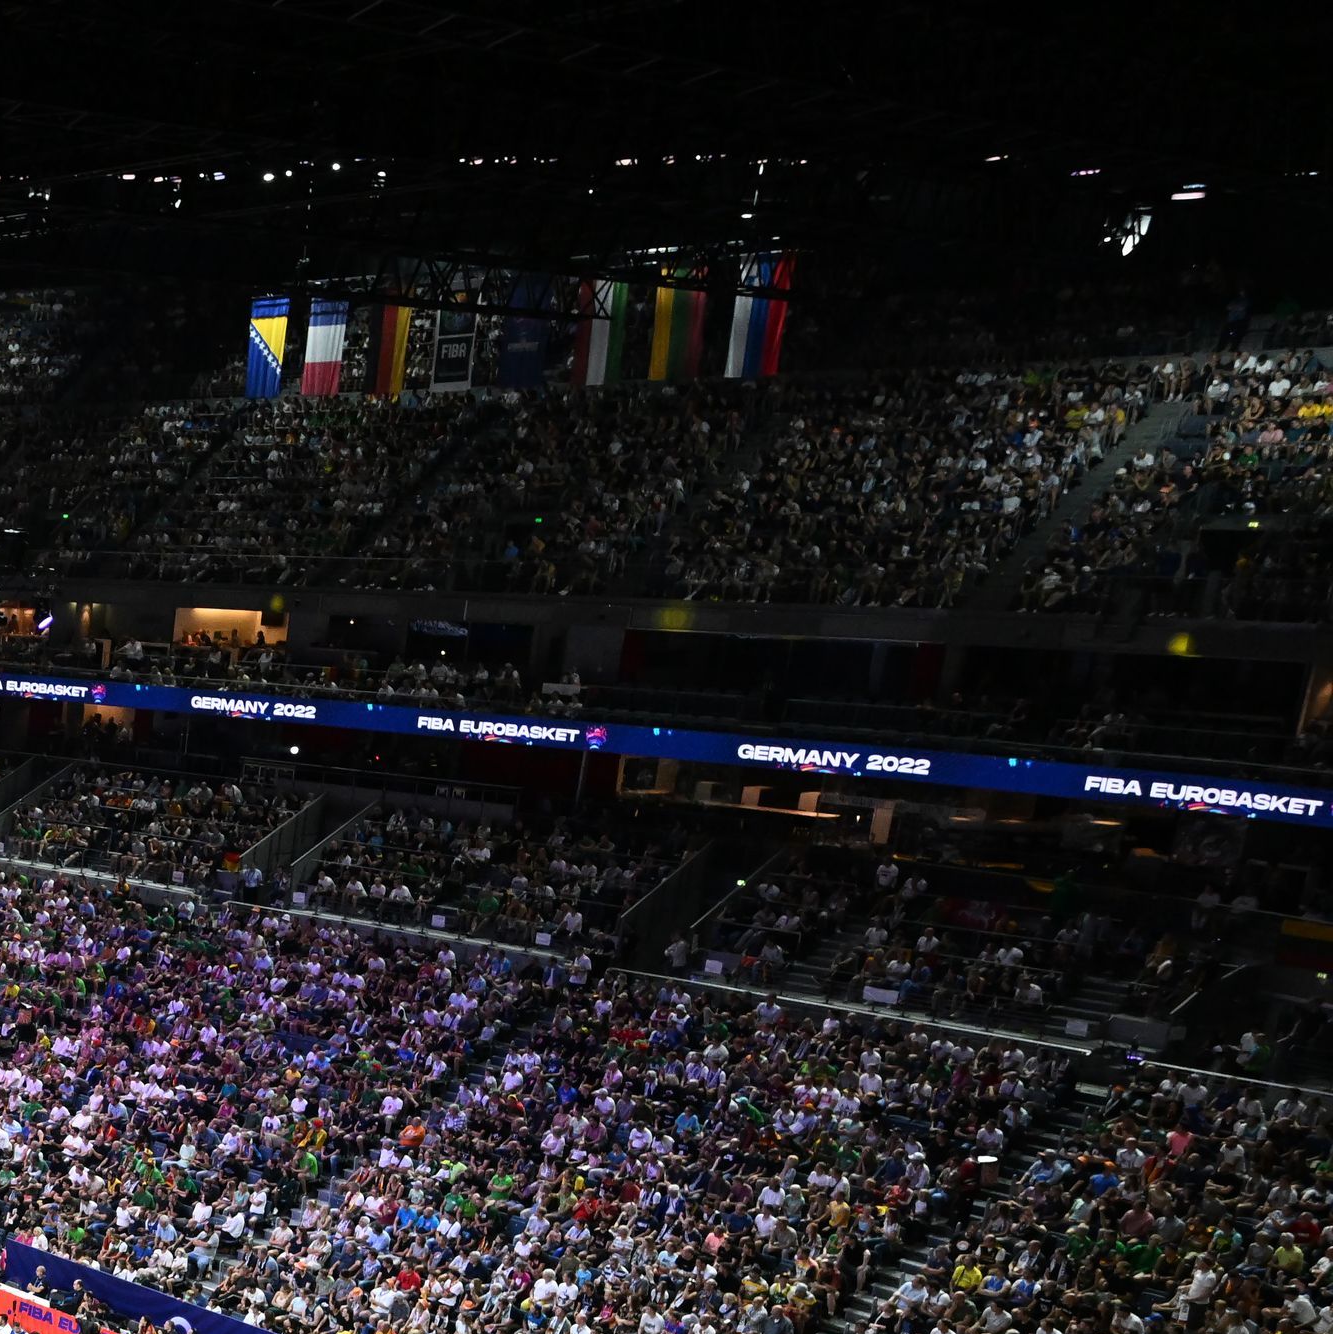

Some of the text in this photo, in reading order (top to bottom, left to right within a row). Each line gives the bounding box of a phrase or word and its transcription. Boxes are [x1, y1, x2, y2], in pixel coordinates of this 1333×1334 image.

[6, 681, 88, 700] EUROBASKET
[191, 696, 316, 718] GERMANY 2022
[418, 716, 580, 745] FIBA EUROBASKET
[738, 744, 930, 775] GERMANY 2022
[1085, 776, 1323, 817] FIBA EUROBASKET
[19, 1300, 56, 1327] FIBA
